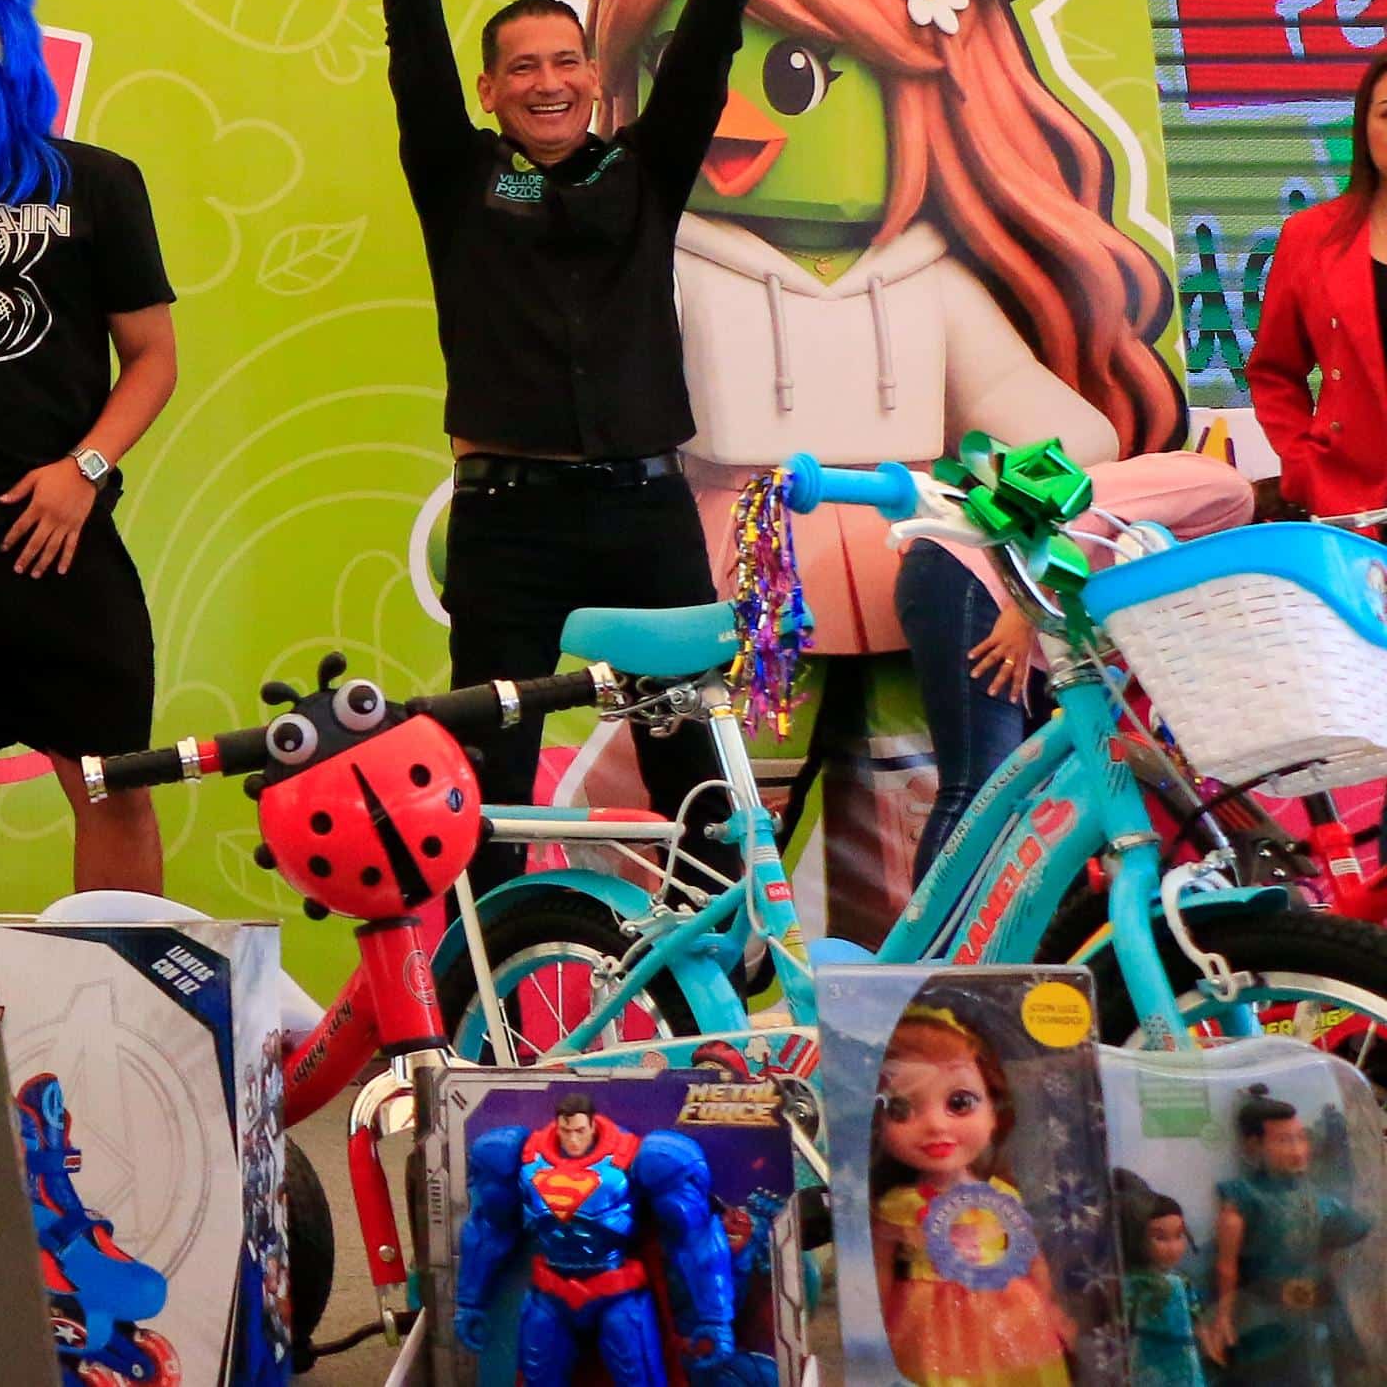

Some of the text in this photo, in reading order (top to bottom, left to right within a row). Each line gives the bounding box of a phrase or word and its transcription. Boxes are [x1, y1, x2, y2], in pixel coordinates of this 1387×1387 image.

[528, 175, 544, 186] DE
[151, 958, 201, 996] CON LUZ
[166, 945, 215, 982] LLANTAS
[678, 1102, 779, 1127] FORCE
